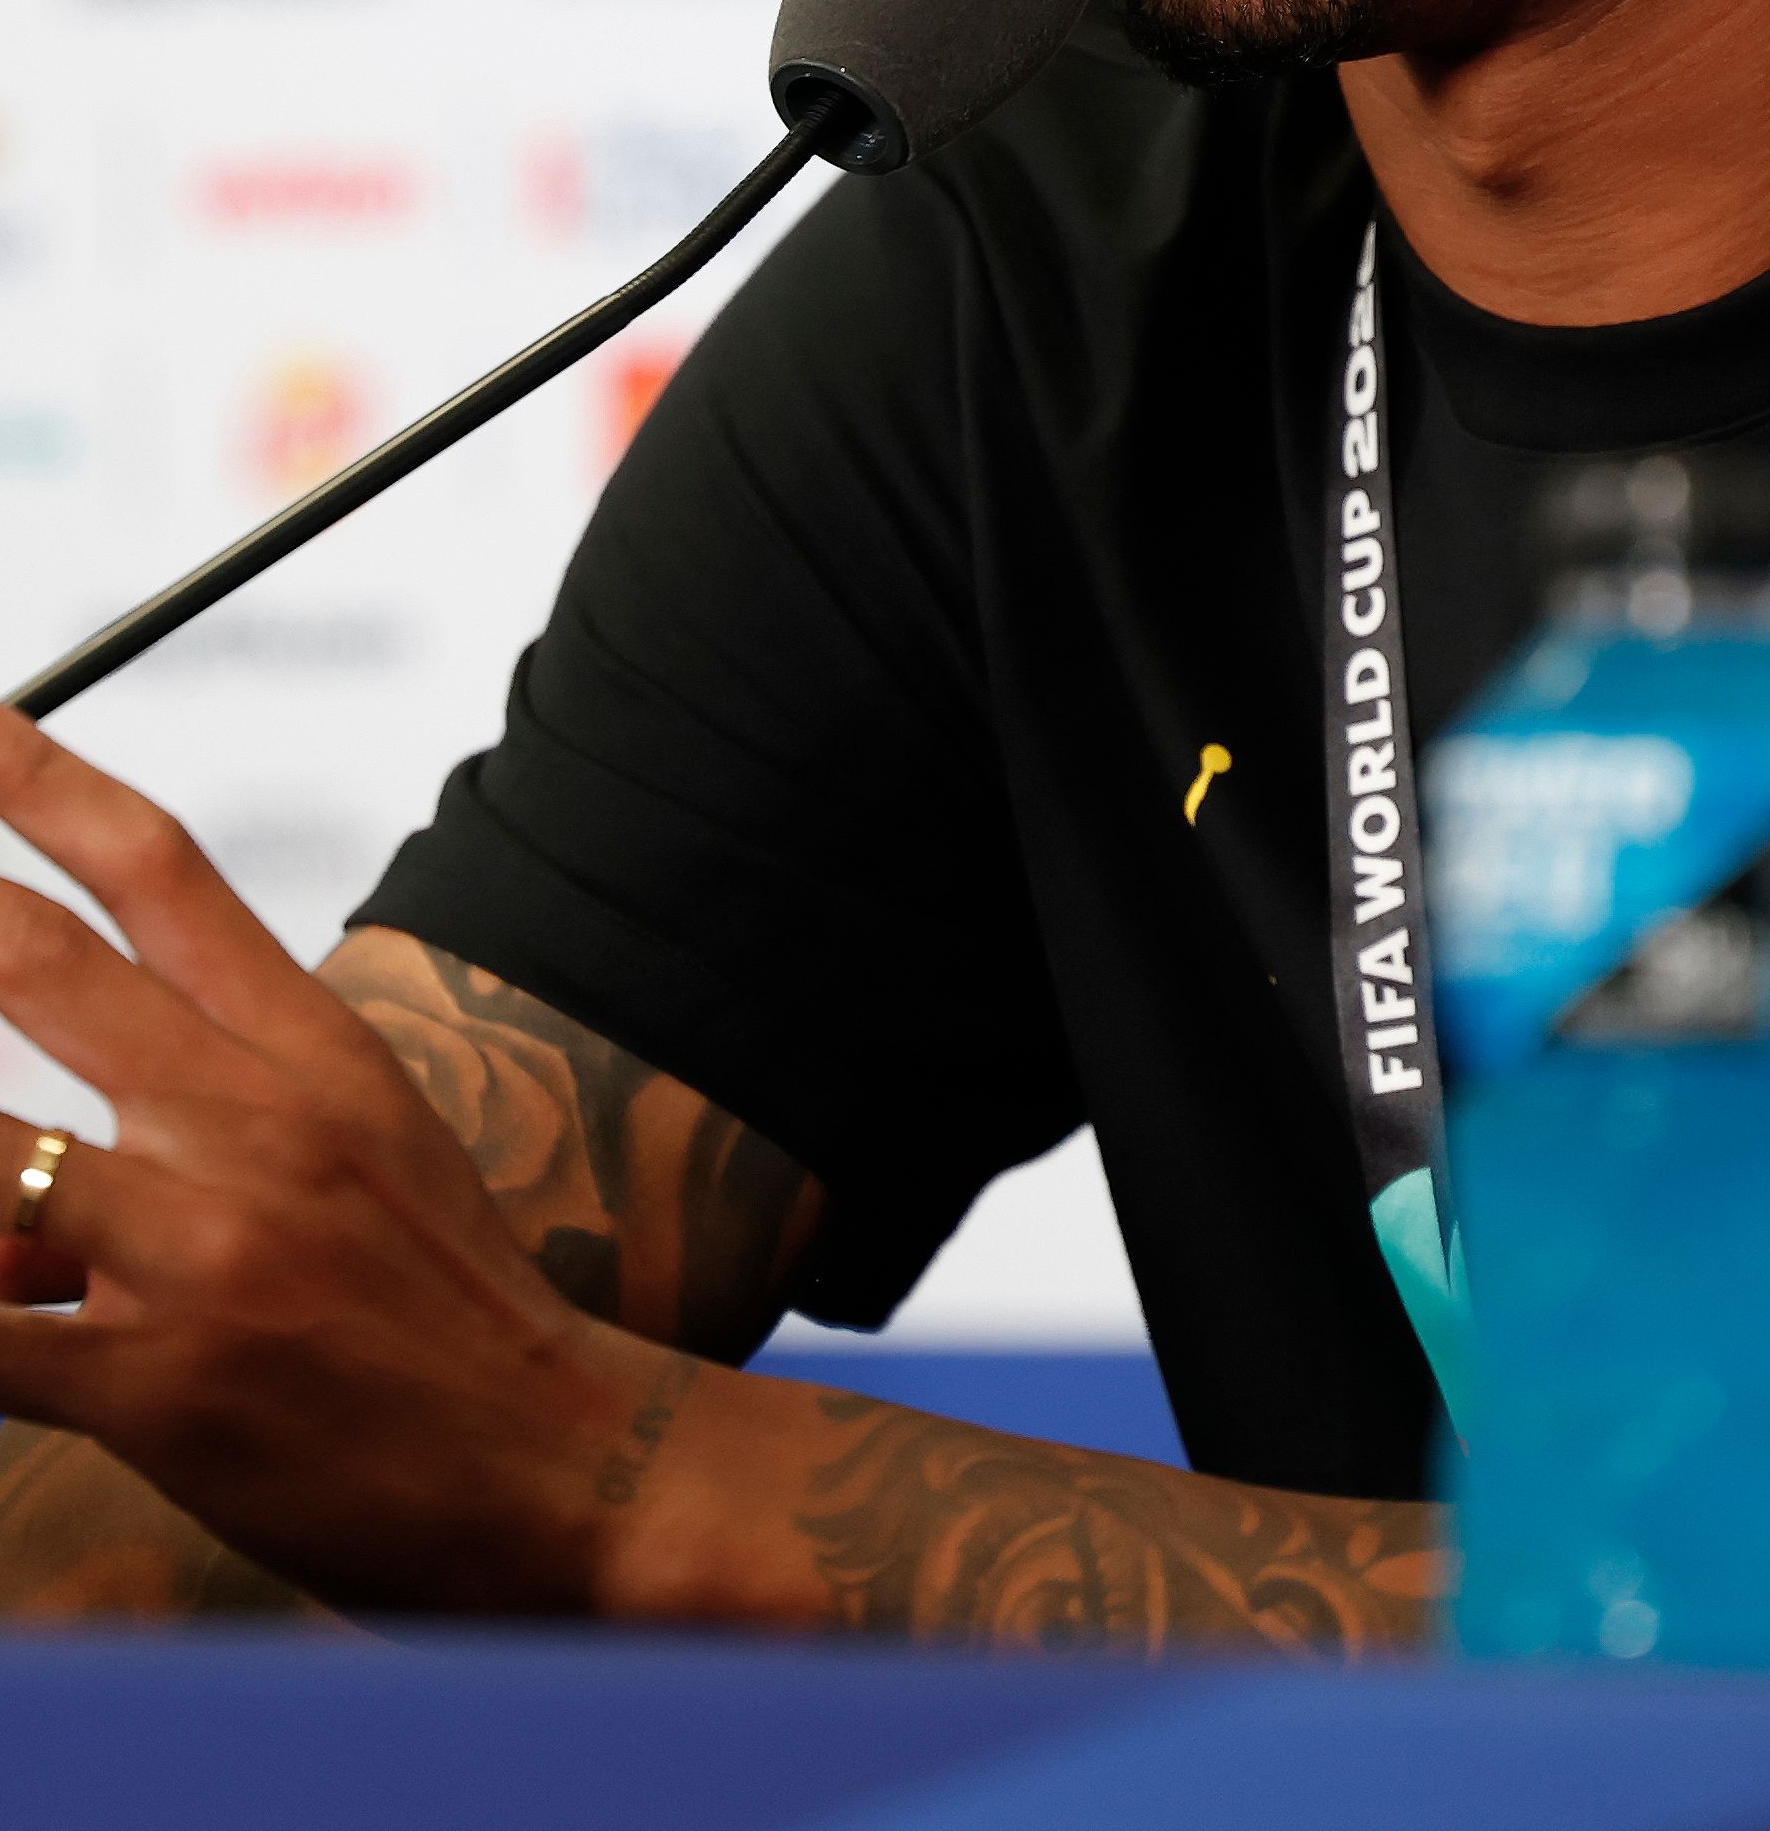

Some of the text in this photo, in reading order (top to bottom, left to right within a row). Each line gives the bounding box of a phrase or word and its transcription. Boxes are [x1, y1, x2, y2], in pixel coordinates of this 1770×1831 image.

[1342, 488, 1385, 637] CUP
[1345, 648, 1406, 924] WORLD
[1368, 925, 1423, 1094] FIFA
